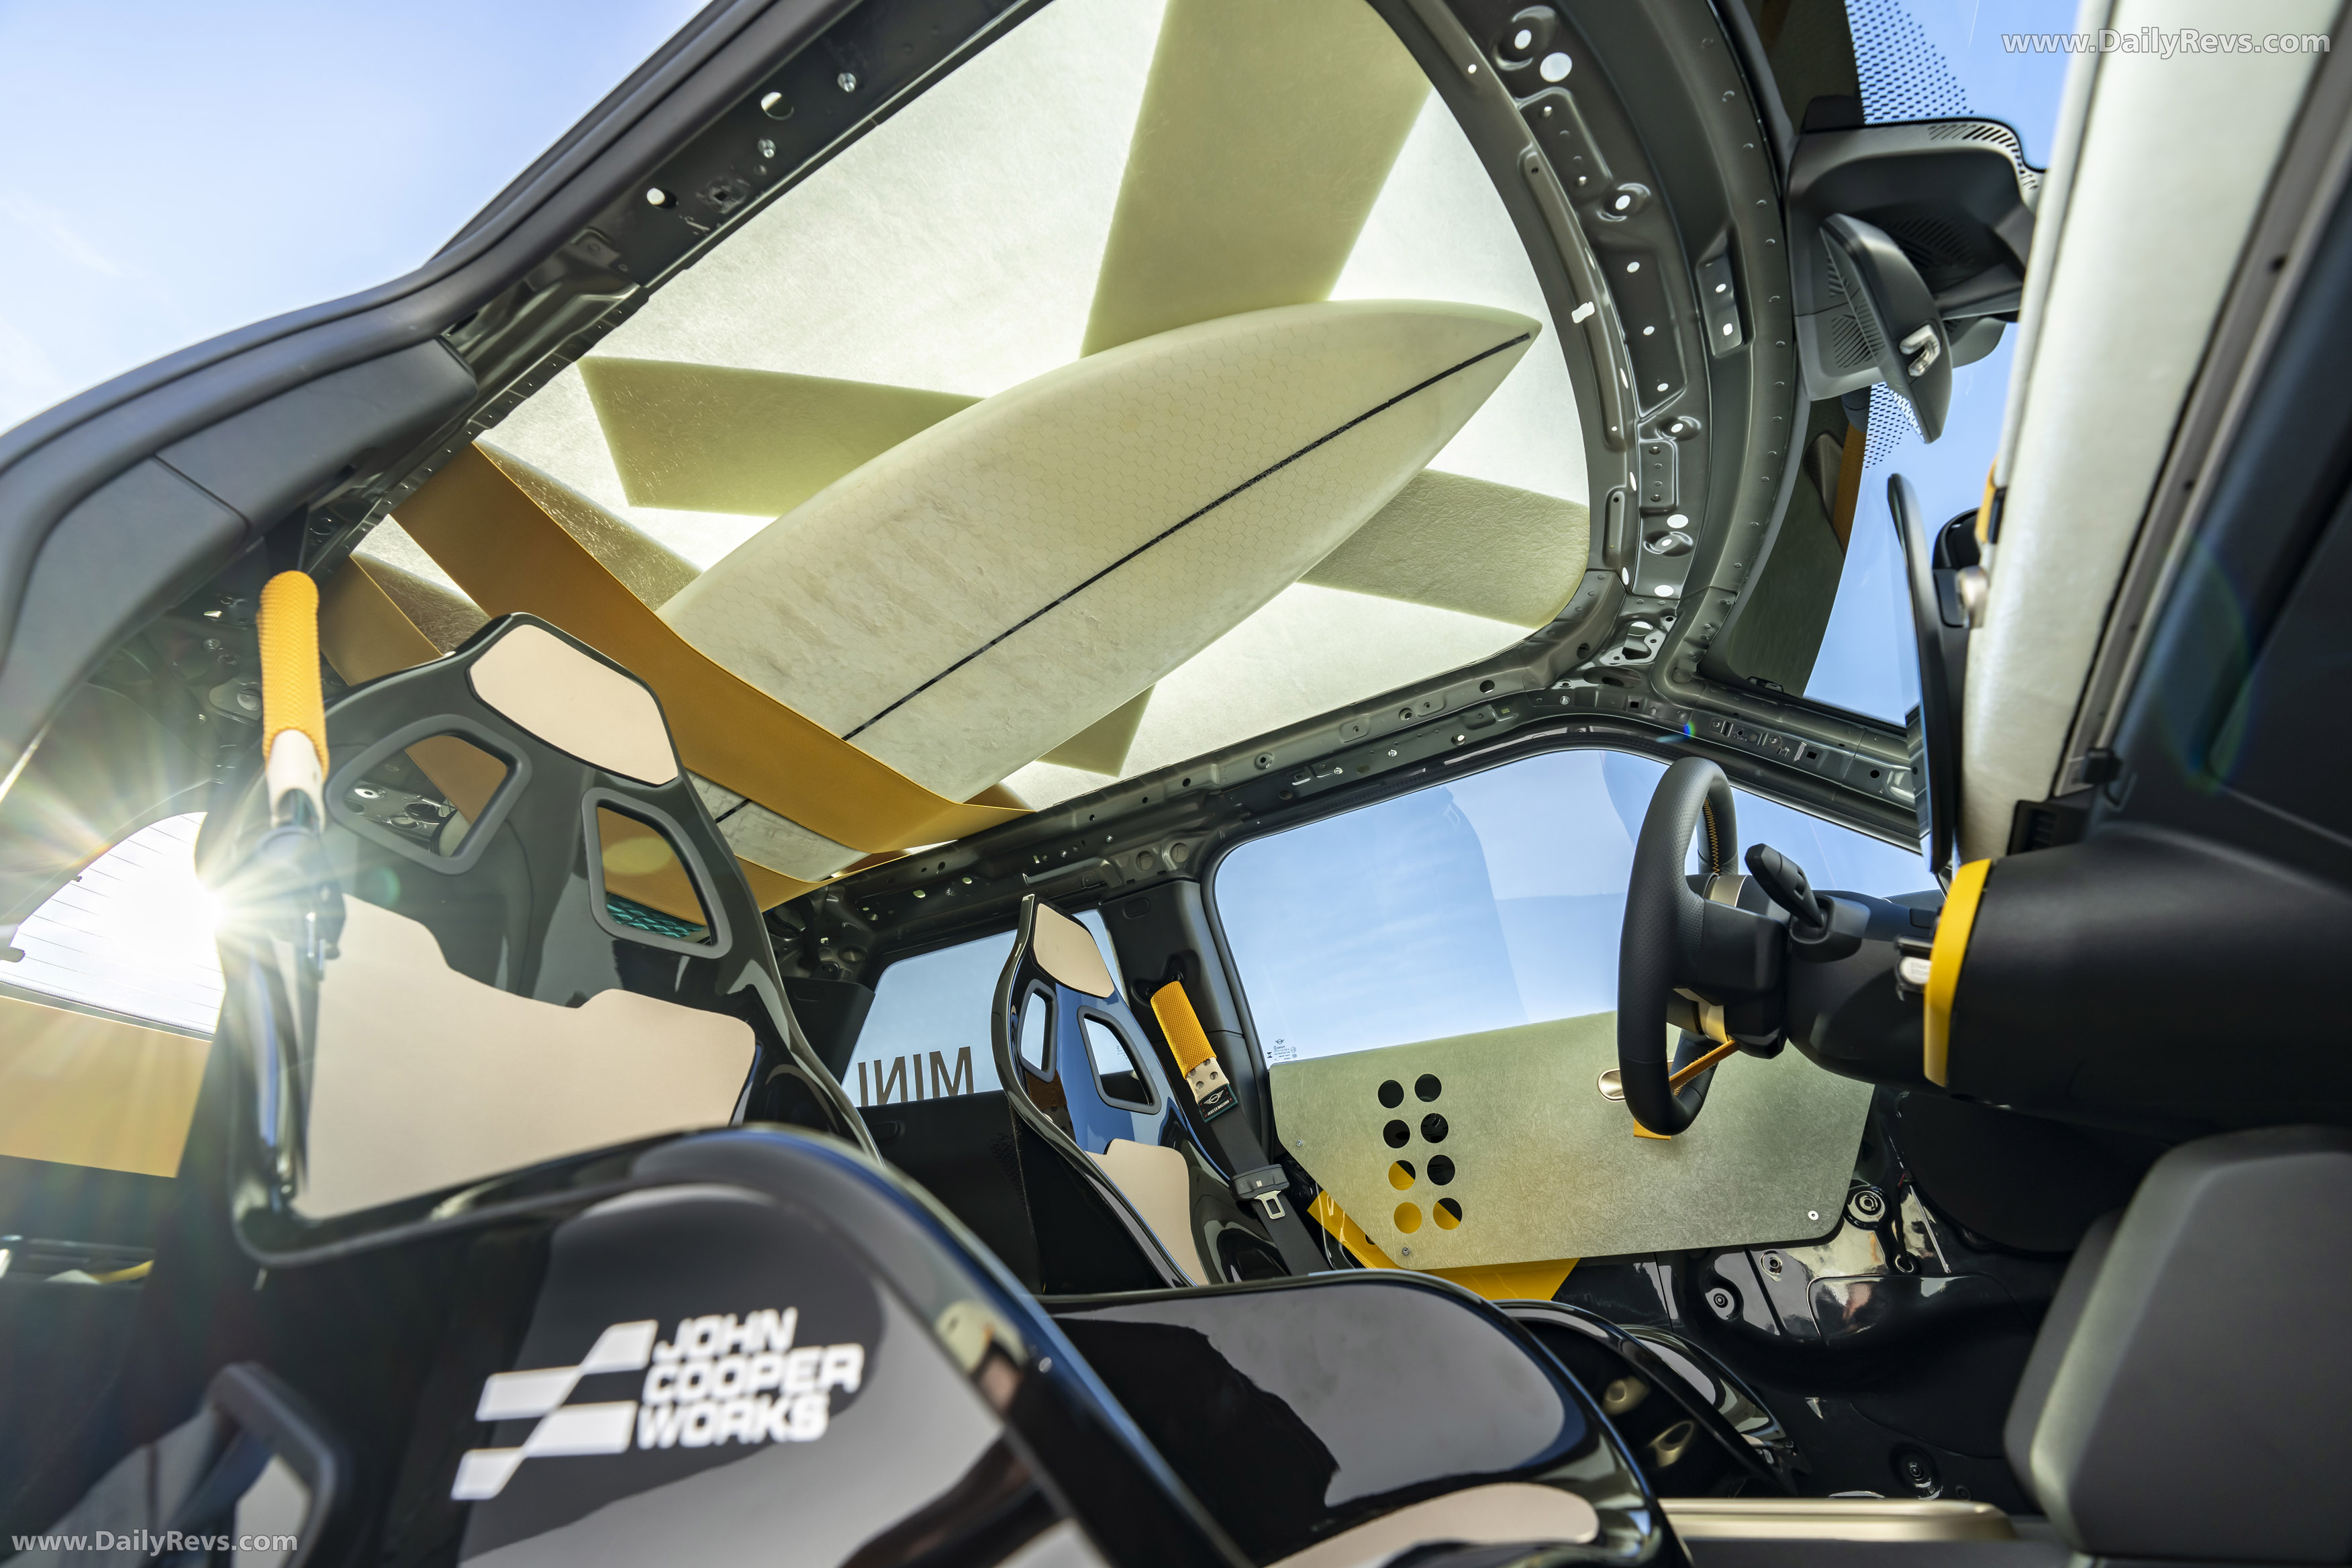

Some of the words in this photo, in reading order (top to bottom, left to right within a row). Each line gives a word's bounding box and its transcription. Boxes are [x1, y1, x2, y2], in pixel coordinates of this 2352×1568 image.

[652, 1306, 797, 1363] JOHN
[642, 1342, 865, 1406] COOPER
[637, 1392, 830, 1450] WORKS
